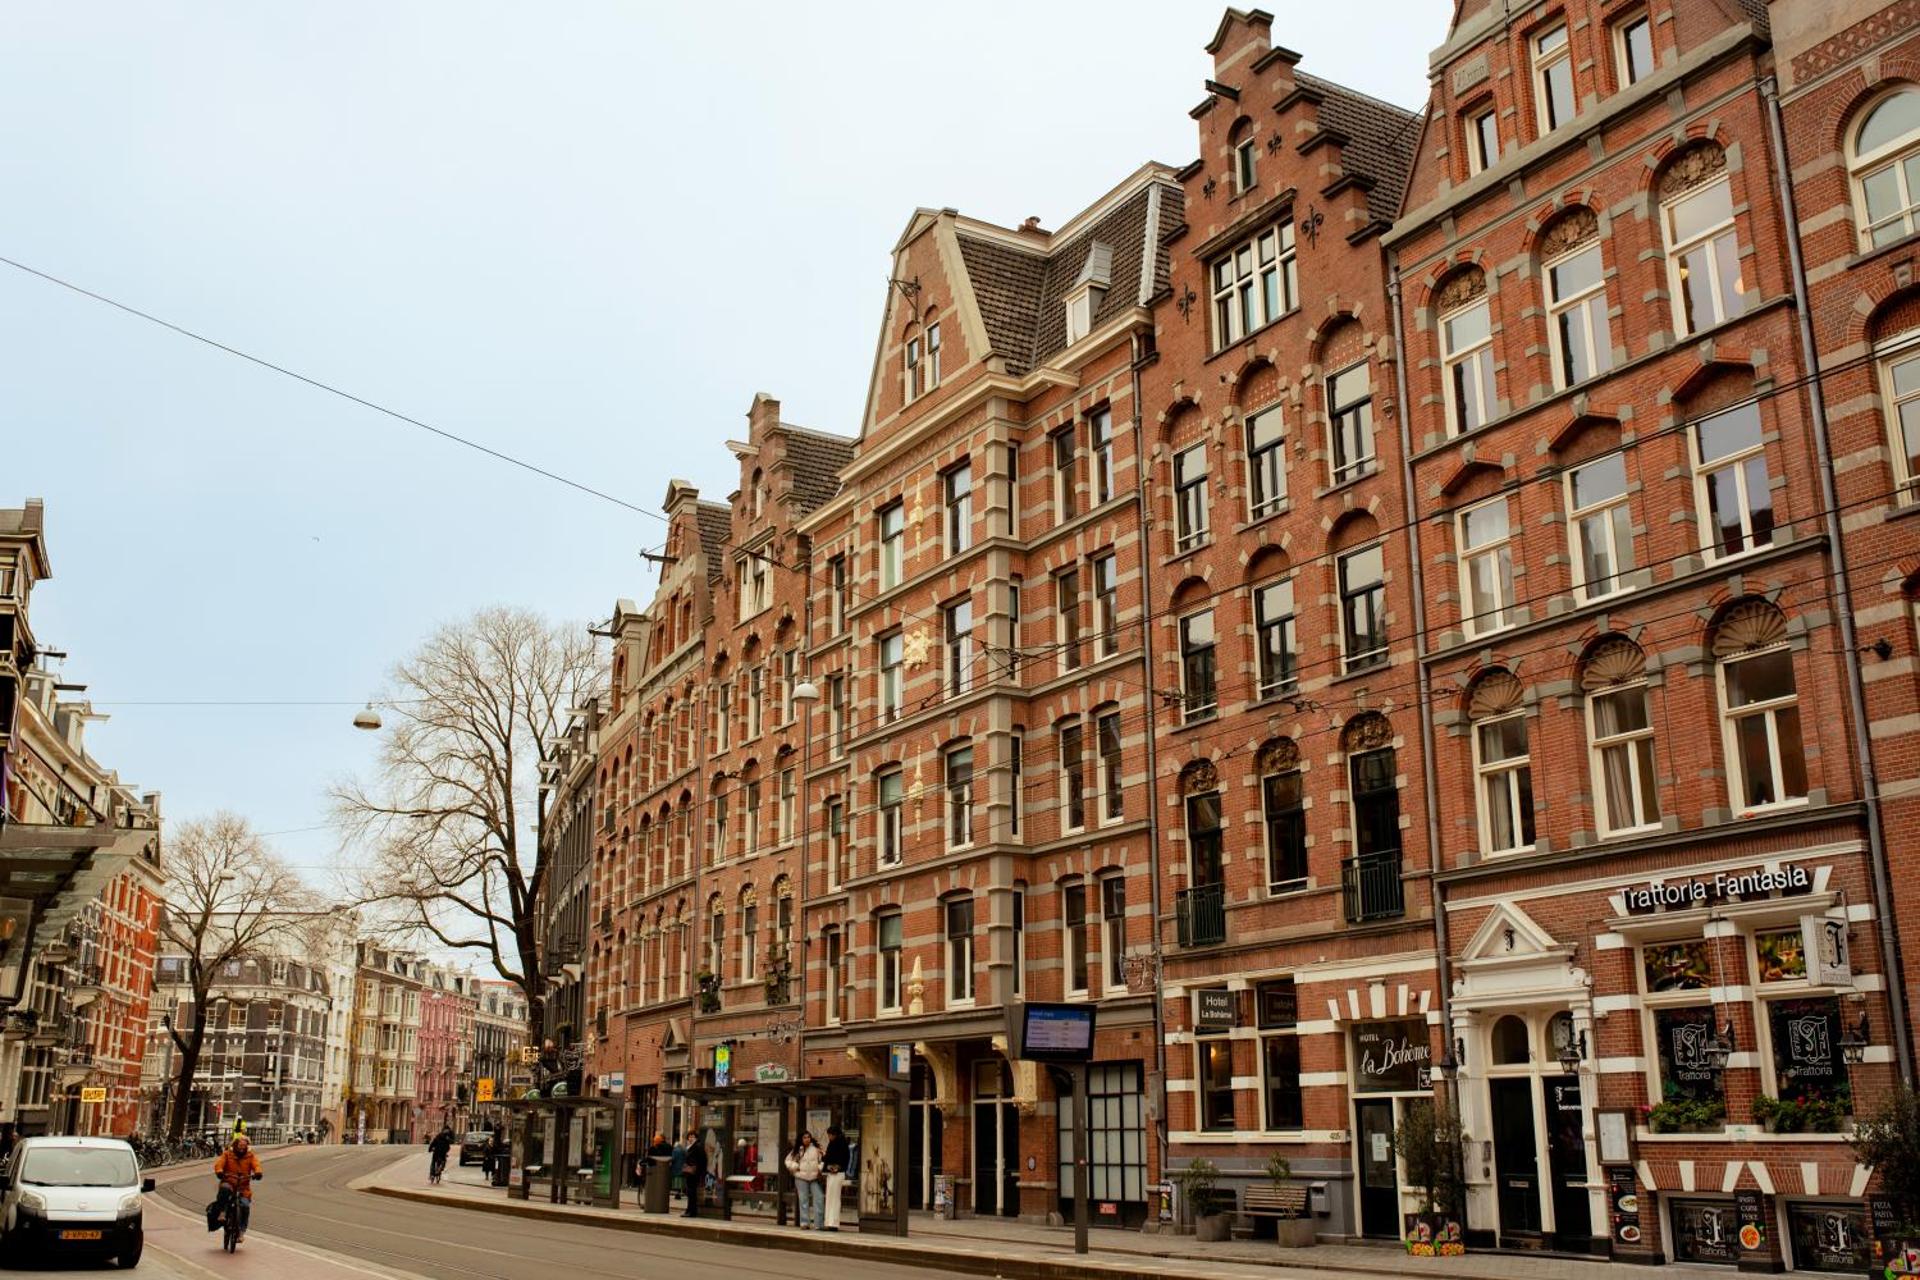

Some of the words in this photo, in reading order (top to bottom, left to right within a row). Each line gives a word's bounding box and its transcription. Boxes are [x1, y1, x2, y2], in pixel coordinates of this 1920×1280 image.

[1617, 880, 1707, 909] Trattoria
[1715, 865, 1808, 897] Fantasia
[1206, 996, 1229, 1007] Hotel
[1360, 1034, 1379, 1042] HOTEL
